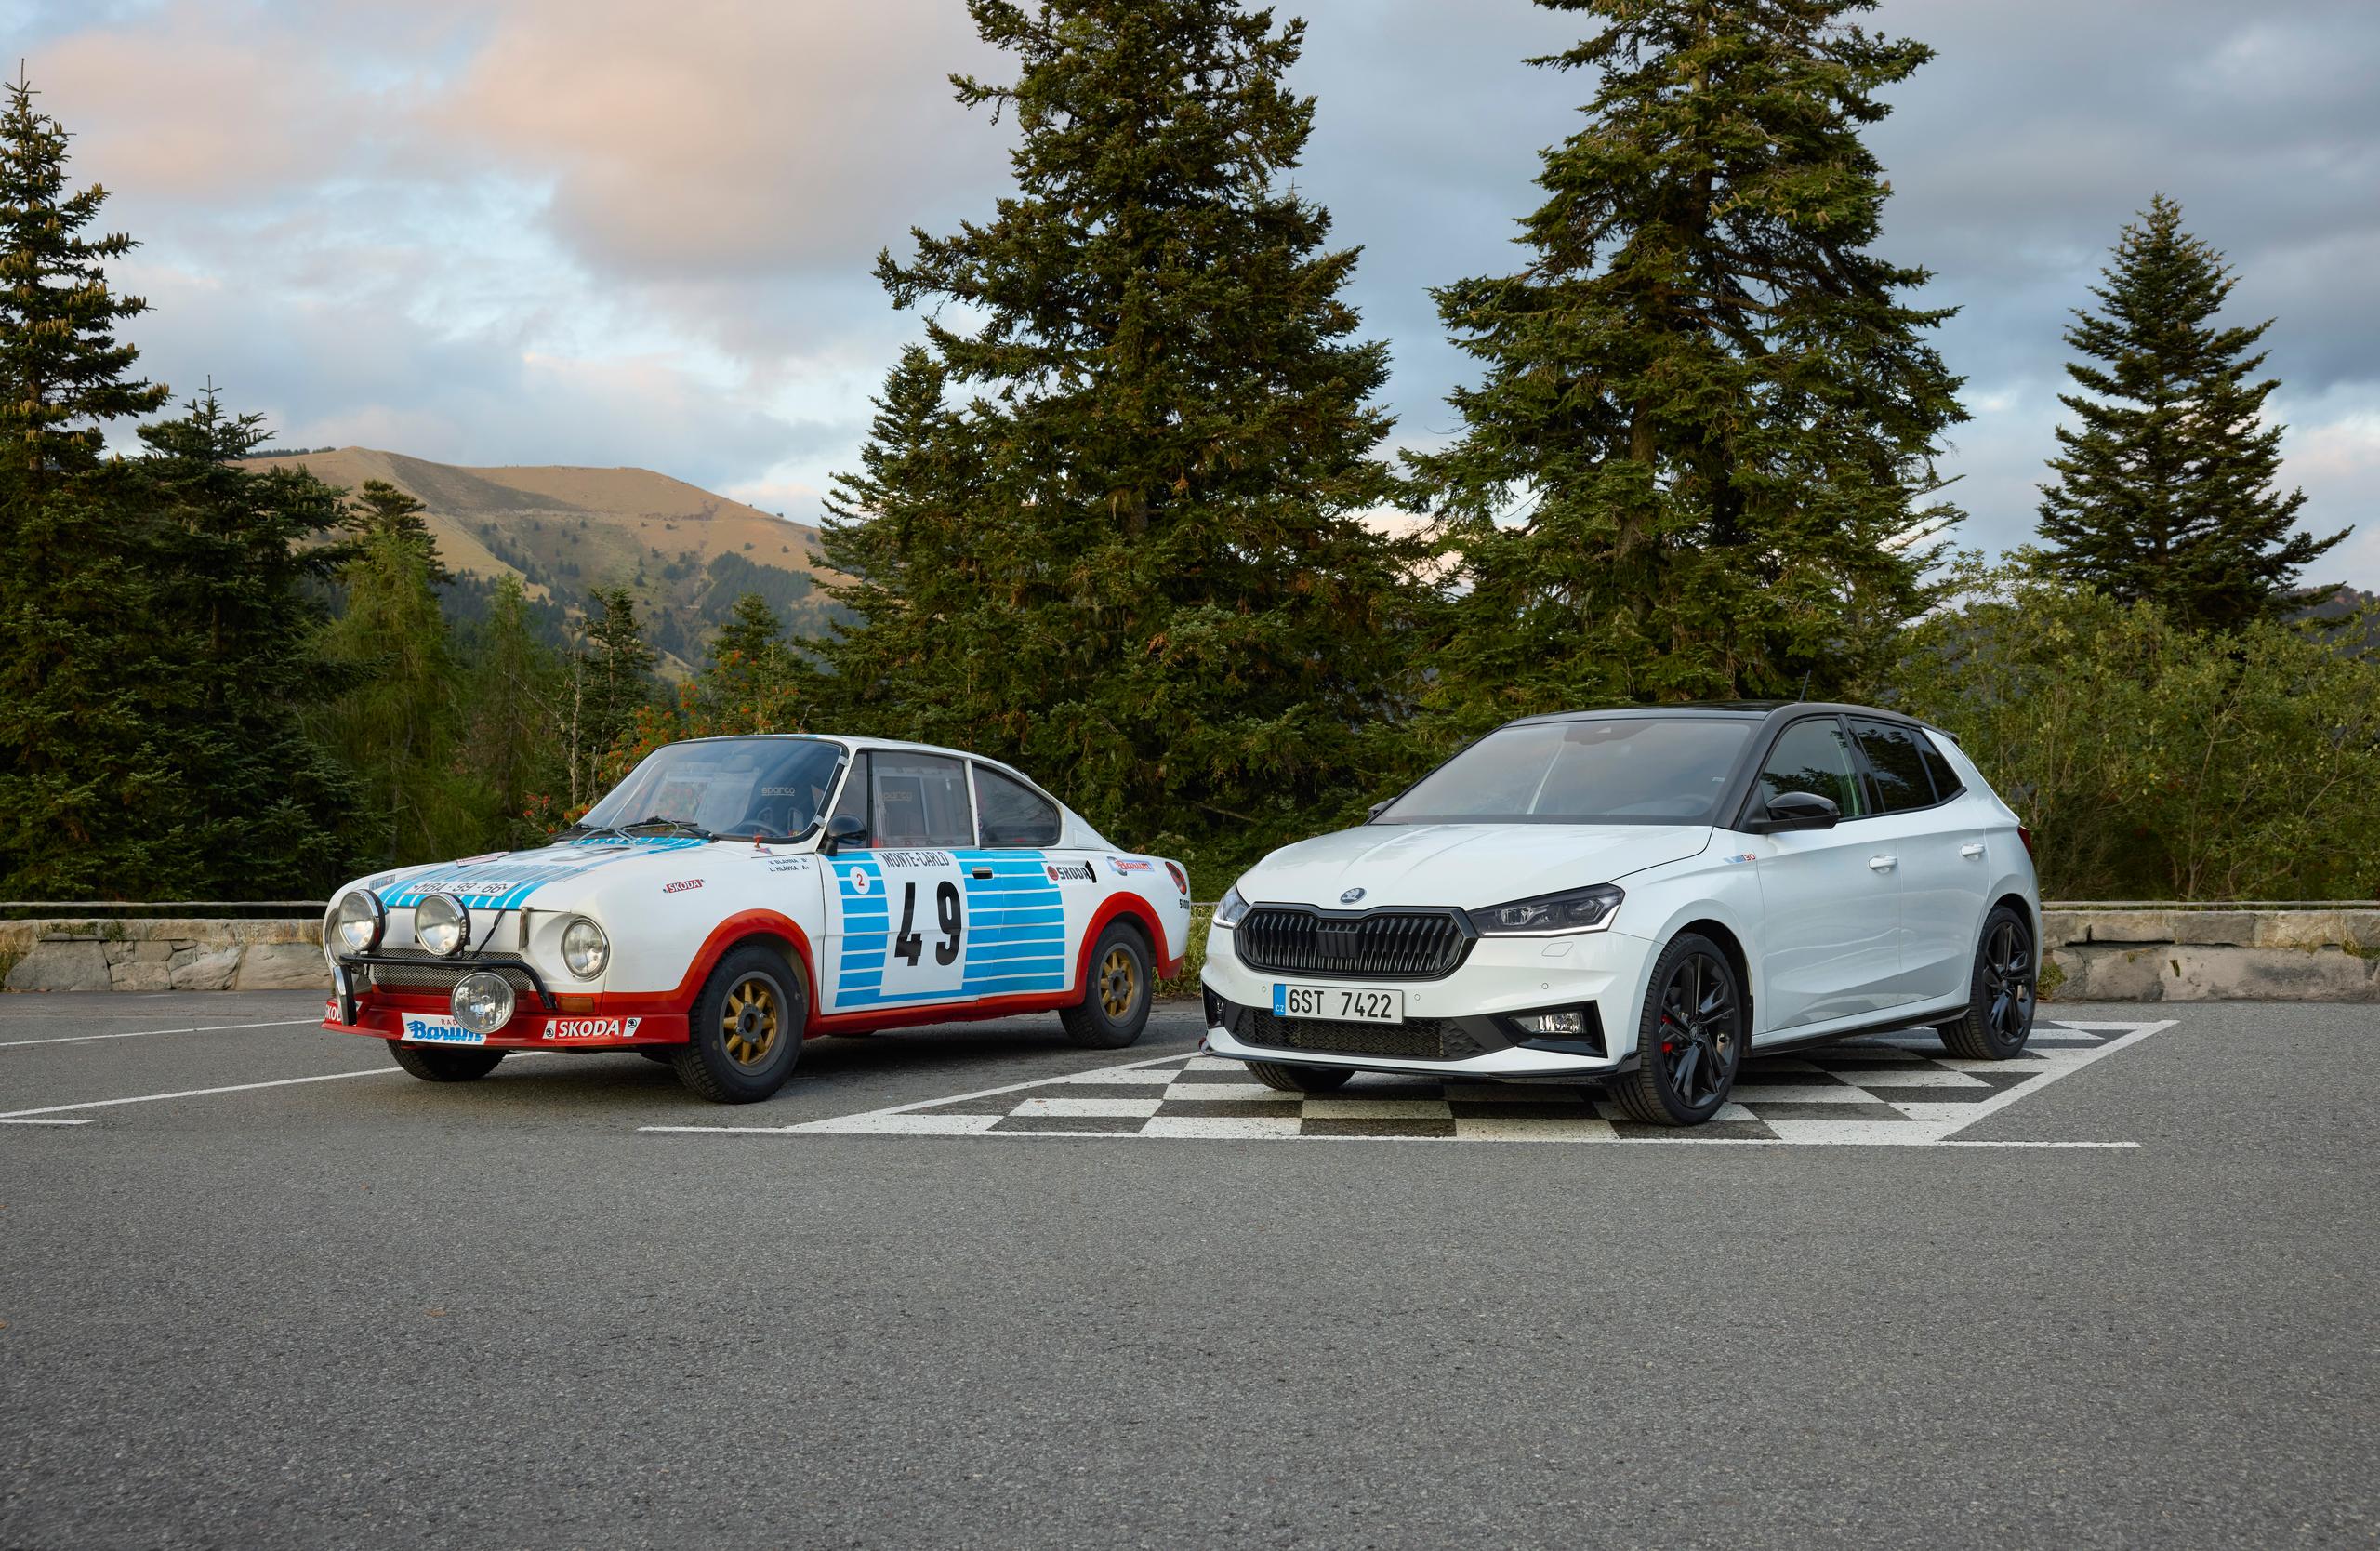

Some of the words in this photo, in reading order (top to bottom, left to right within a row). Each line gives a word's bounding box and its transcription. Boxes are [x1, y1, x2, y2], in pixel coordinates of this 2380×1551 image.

[761, 787, 795, 795] sparco
[879, 852, 950, 867] MONTE-CARLO
[668, 880, 700, 893] SKODA
[856, 873, 865, 886] 2
[894, 881, 961, 966] 49
[1289, 989, 1324, 1014] 6ST
[1342, 991, 1392, 1018] 7422
[558, 1019, 620, 1037] SKODA
